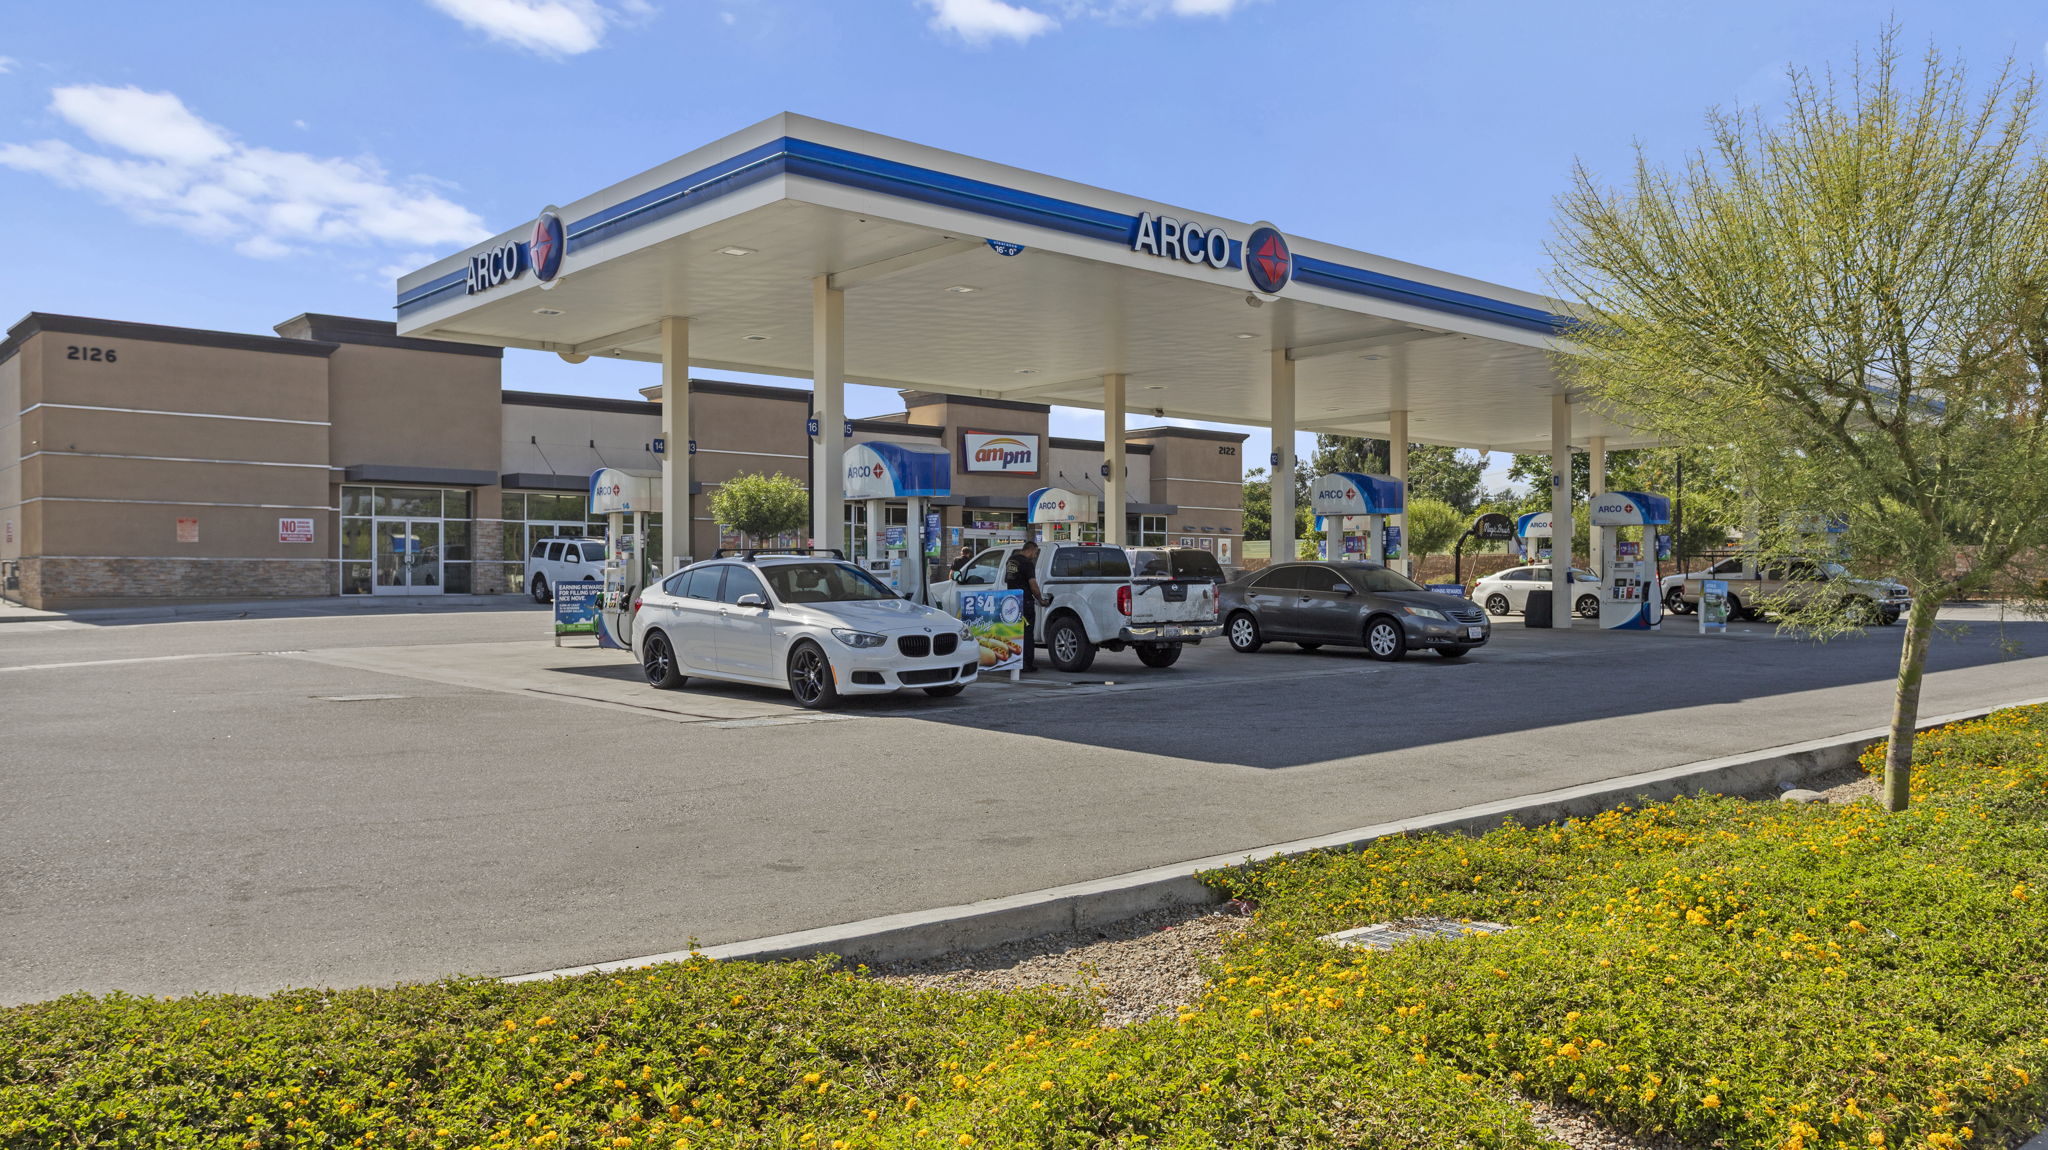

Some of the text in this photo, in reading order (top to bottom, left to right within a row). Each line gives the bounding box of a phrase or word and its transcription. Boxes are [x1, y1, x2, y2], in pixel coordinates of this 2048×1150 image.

[1134, 212, 1230, 269] ARCO
[465, 240, 519, 295] ARCO
[67, 345, 117, 363] 2126
[808, 422, 817, 432] 16
[655, 441, 664, 451] 14
[1218, 446, 1236, 456] 2122
[975, 447, 1032, 470] ampm
[847, 465, 871, 479] ARCO
[596, 486, 612, 496] ARCO
[1318, 490, 1343, 499] ARCO
[1038, 501, 1056, 510] ARCO
[1598, 505, 1622, 513] ARCO
[281, 520, 296, 533] NO
[965, 597, 975, 610] 2
[977, 595, 996, 615] $4
